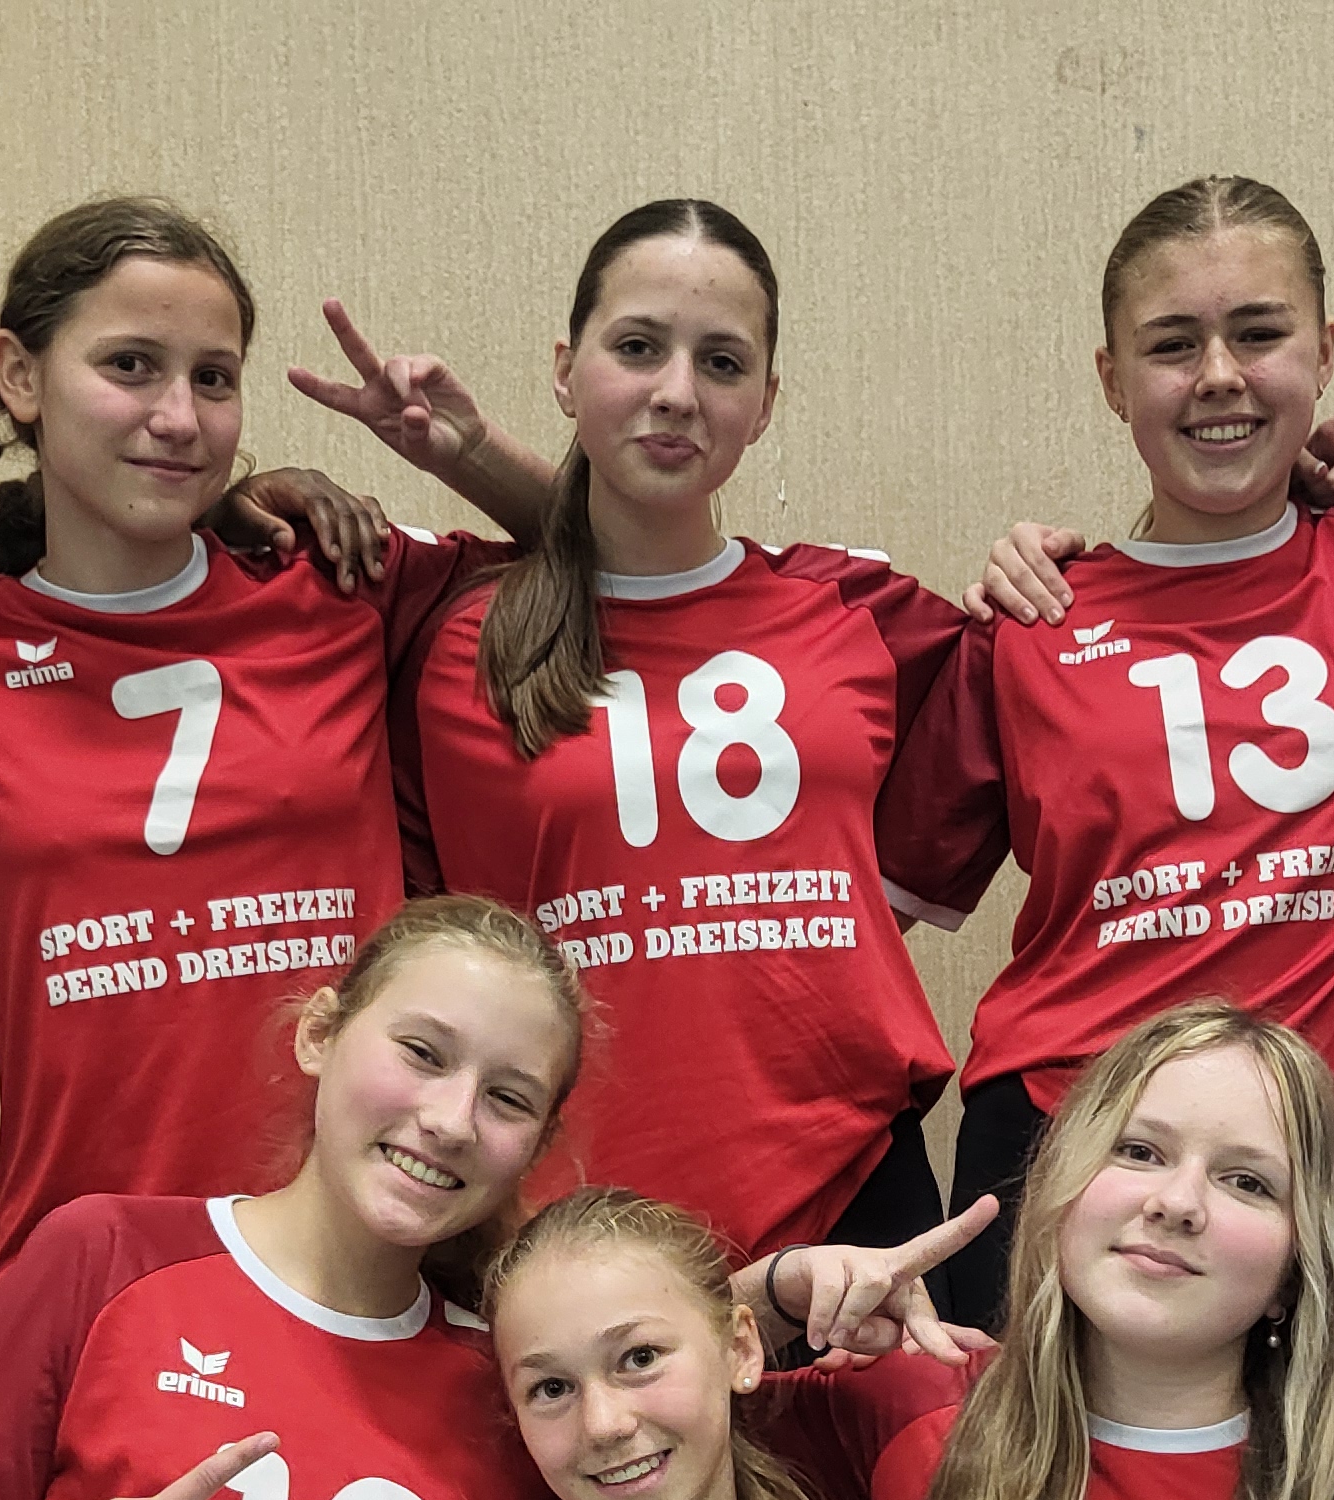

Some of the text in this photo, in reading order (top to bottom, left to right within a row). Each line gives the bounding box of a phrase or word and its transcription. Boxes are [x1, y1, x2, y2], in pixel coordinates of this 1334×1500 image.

[5, 660, 74, 689] erima
[1059, 637, 1132, 665] erima
[112, 659, 223, 856] 7
[589, 650, 801, 848] 18
[641, 885, 665, 911] +
[680, 870, 852, 909] FREIZEIT
[1093, 861, 1205, 910] SPORT
[1221, 861, 1243, 886] +
[40, 888, 356, 961] SPORT + FREIZEIT
[557, 916, 857, 969] RND DREISBACH
[1096, 904, 1211, 949] BERND
[46, 956, 168, 1007] BERND
[157, 1371, 246, 1409] erima
